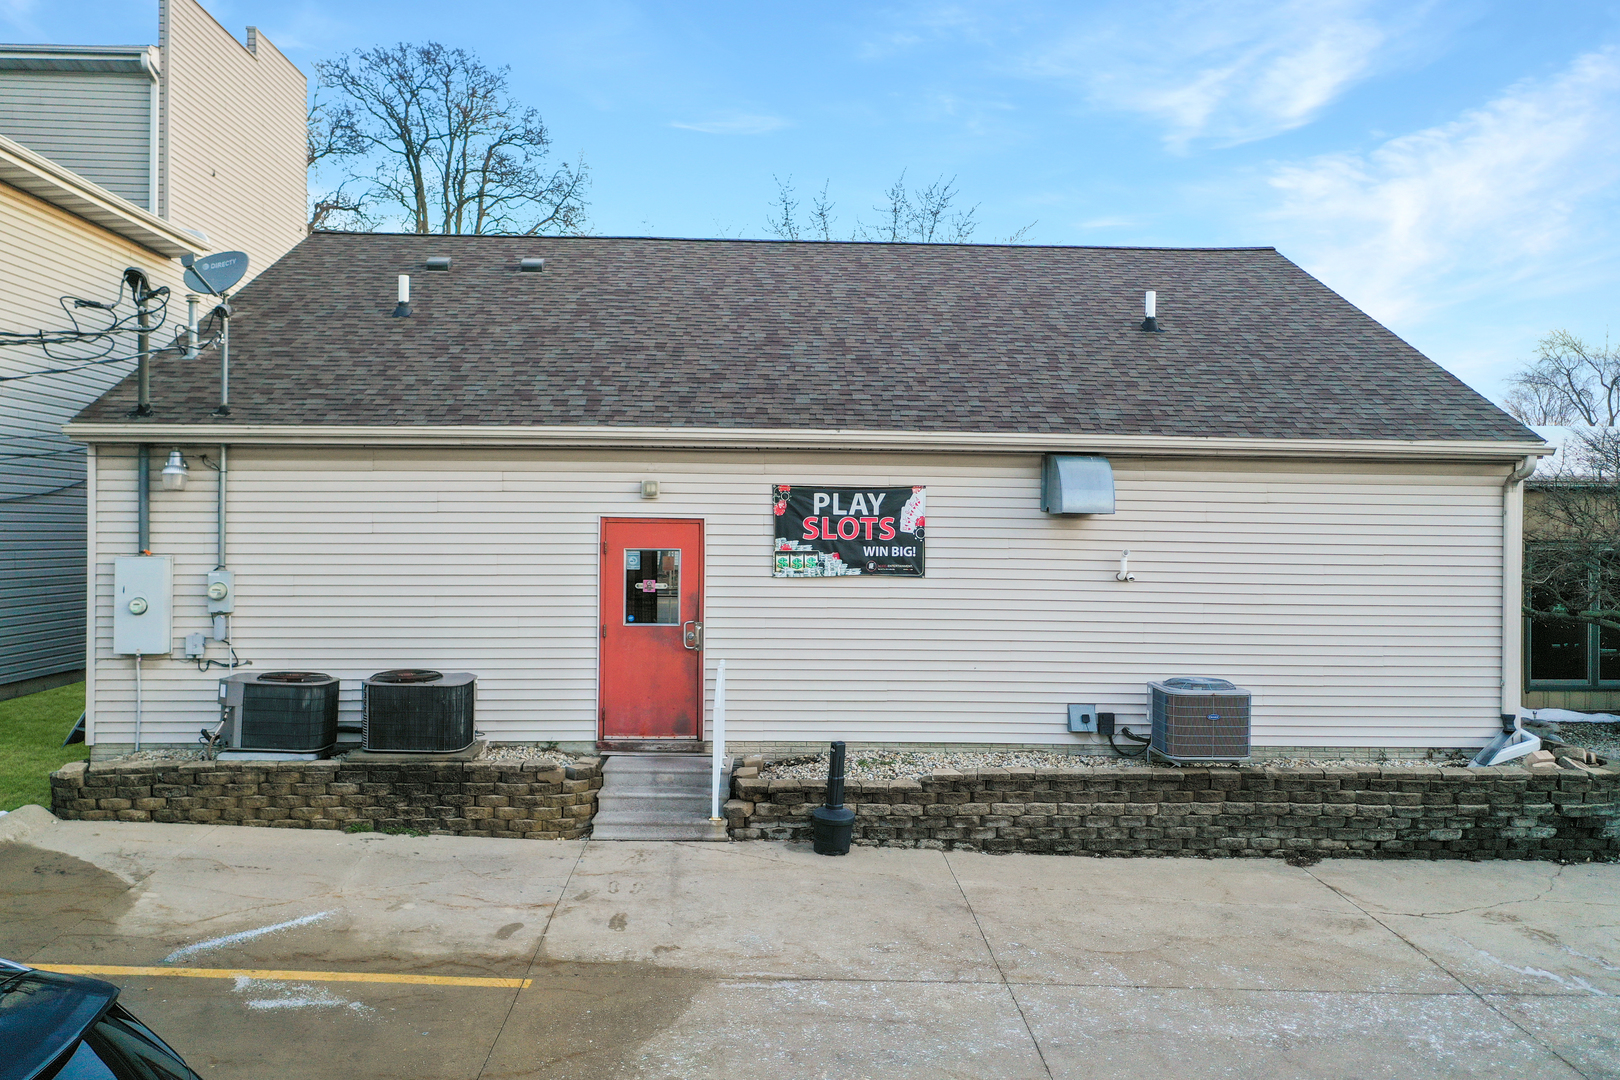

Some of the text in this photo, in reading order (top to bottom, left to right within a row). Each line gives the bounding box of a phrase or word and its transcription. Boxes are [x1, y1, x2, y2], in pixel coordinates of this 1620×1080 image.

[813, 492, 886, 516] PLAY
[802, 516, 896, 541] SLOTS
[863, 546, 916, 557] WIN BIG!
